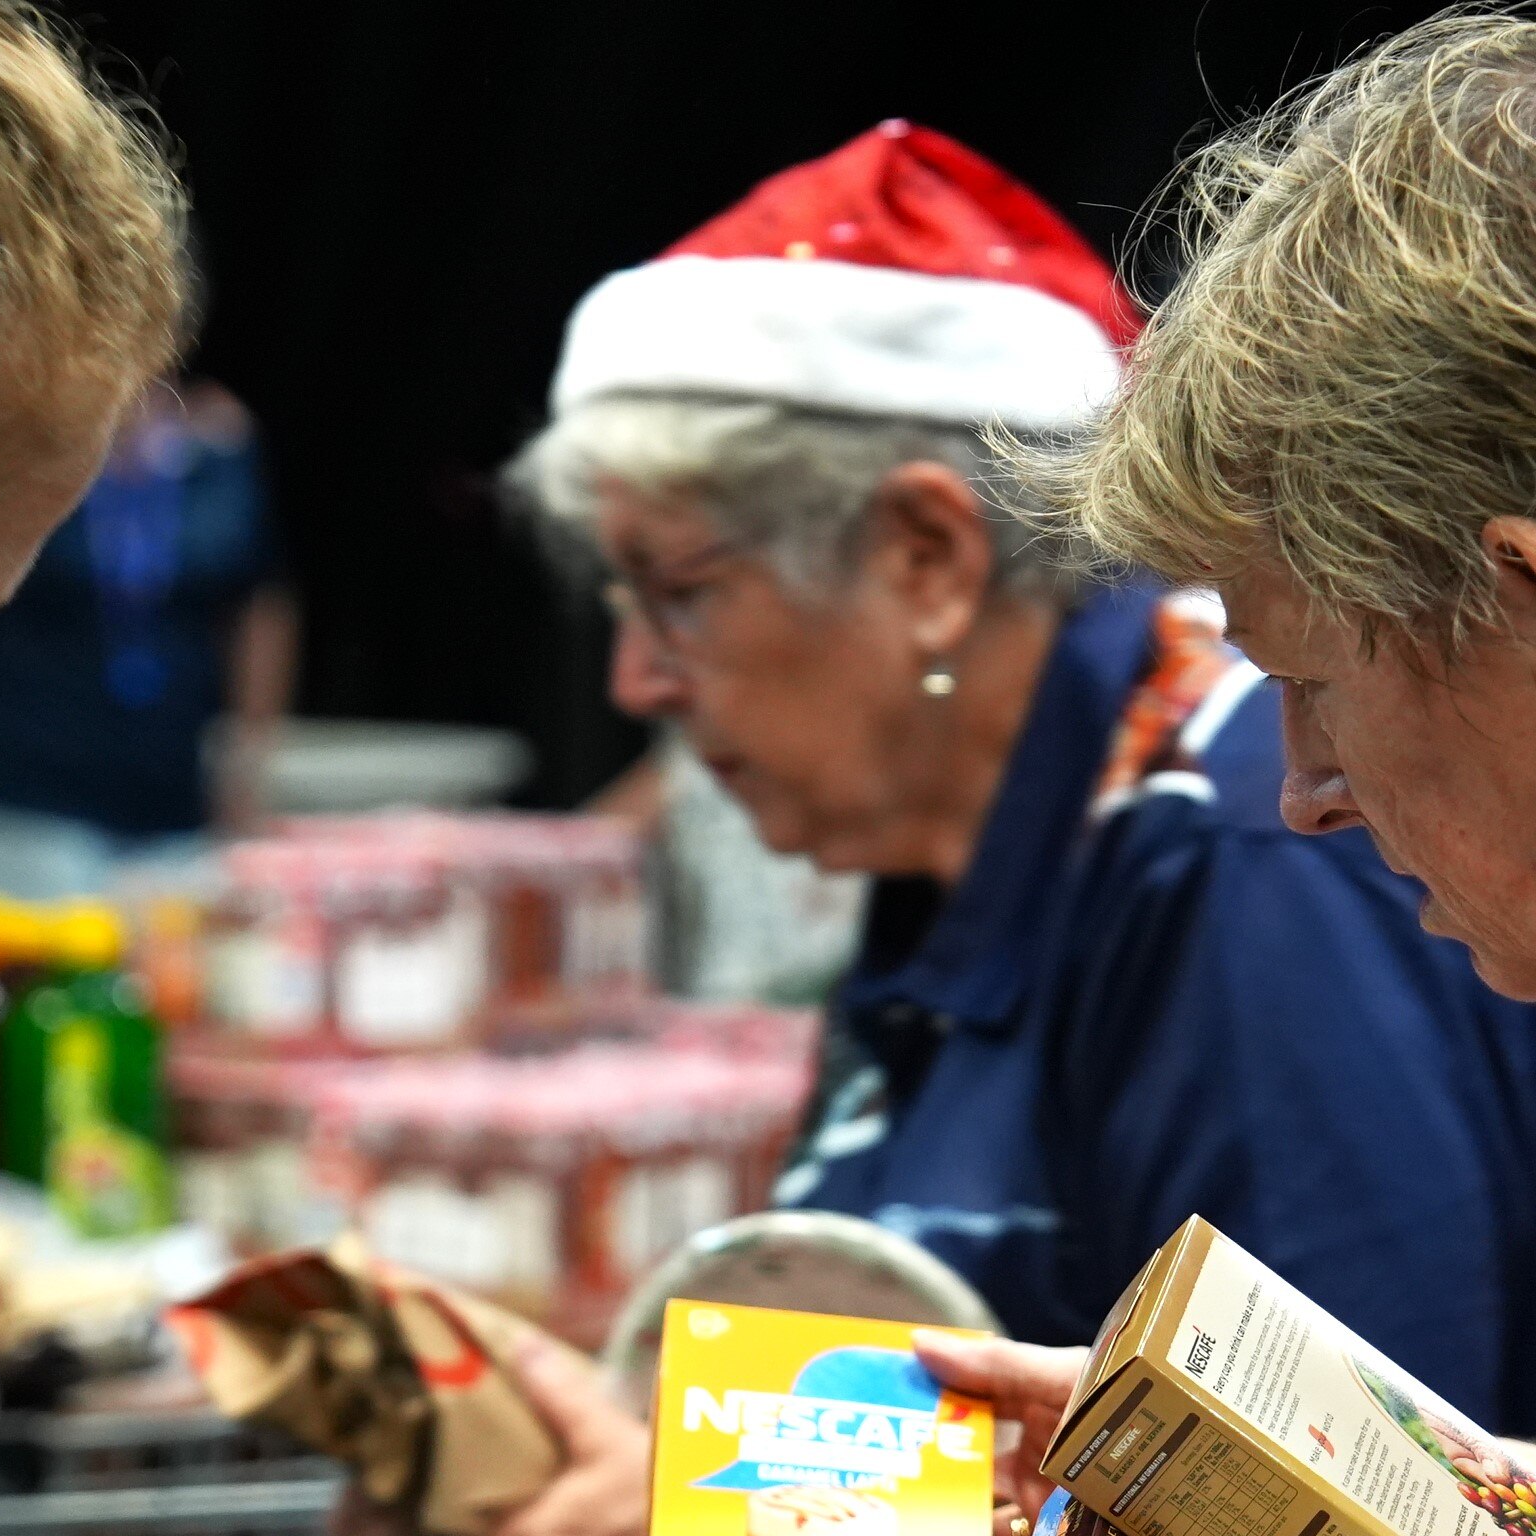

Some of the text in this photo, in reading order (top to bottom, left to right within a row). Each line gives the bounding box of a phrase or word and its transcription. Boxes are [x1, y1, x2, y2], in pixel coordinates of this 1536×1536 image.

[1238, 1307, 1252, 1327] make
[1236, 1324, 1246, 1338] can
[1183, 1325, 1217, 1379] NESCAFÉ
[1228, 1334, 1241, 1353] drink
[1221, 1362, 1233, 1377] cup
[1225, 1351, 1238, 1366] you
[1212, 1372, 1229, 1395] Every
[1118, 1454, 1137, 1474] SACHET
[1145, 1419, 1166, 1442] SERVING
[1309, 1444, 1322, 1466] Make
[1319, 1410, 1334, 1433] world
[1066, 1428, 1110, 1478] KNOW YOUR PORTION
[1112, 1450, 1167, 1513] NUTRITIONAL INFORMATION
